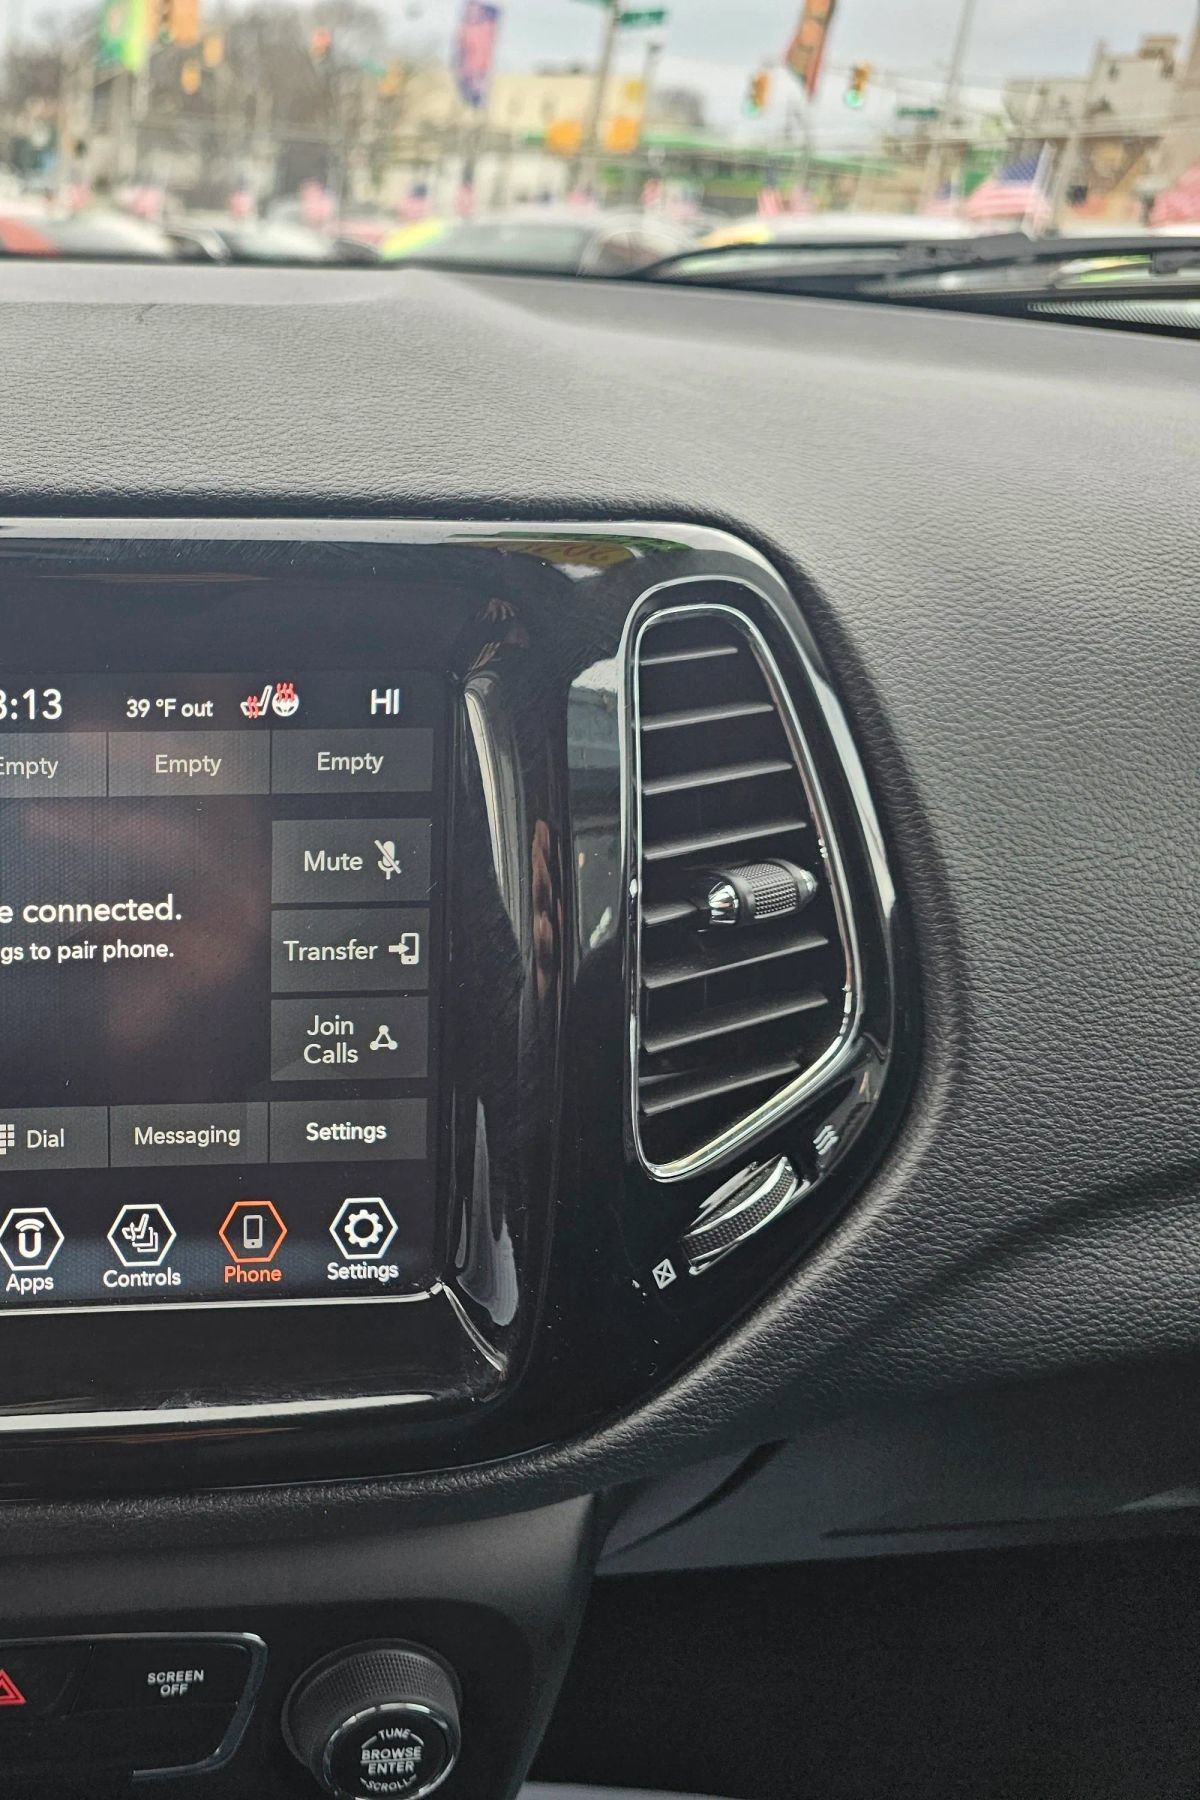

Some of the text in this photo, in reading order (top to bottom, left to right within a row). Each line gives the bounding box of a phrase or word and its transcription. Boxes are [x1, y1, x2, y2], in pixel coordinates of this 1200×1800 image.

[126, 698, 151, 718] 39
[181, 700, 214, 718] out
[370, 688, 400, 715] HI
[155, 754, 222, 777] Empty
[317, 751, 384, 775] Empty
[304, 850, 363, 872] Mute
[22, 893, 182, 924] connected.
[29, 942, 52, 961] to
[57, 940, 98, 964] pair
[102, 938, 175, 963] phone.
[282, 938, 379, 962] Transfer
[306, 1014, 354, 1036] Join
[303, 1041, 359, 1064] Calls
[27, 1127, 65, 1149] Dial
[134, 1124, 241, 1148] Messaging
[306, 1121, 387, 1144] Settings
[102, 1266, 182, 1288] Controls
[224, 1264, 282, 1283] Phone
[327, 1260, 400, 1283] Settings
[5, 1273, 55, 1296] Apps
[147, 1669, 204, 1684] SCREEN
[159, 1683, 189, 1697] OFF
[377, 1727, 411, 1741] TUNE
[360, 1745, 422, 1761] BROWSE
[367, 1761, 415, 1776] ENTER
[366, 1776, 412, 1793] SCROLL
